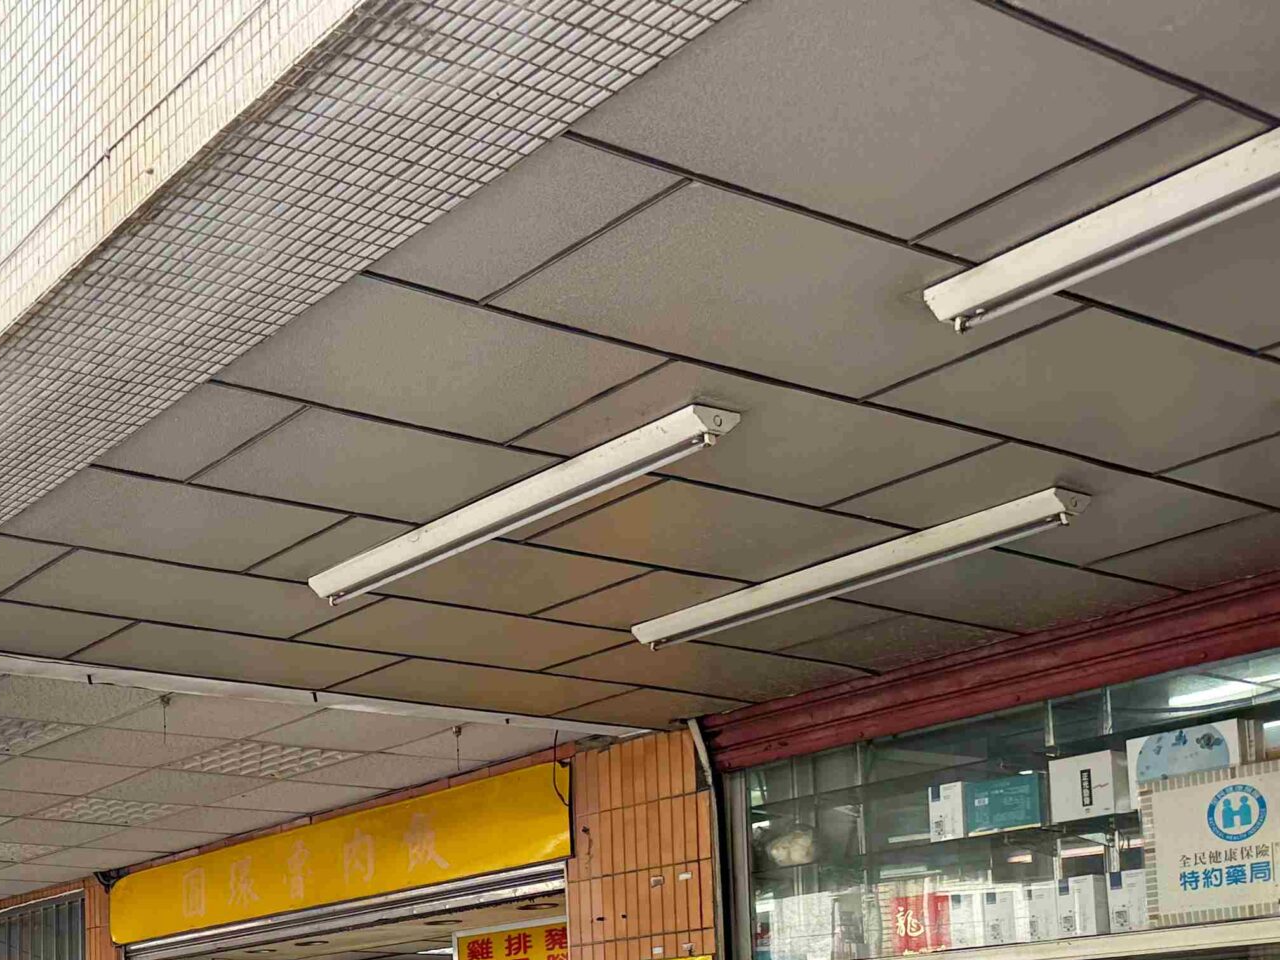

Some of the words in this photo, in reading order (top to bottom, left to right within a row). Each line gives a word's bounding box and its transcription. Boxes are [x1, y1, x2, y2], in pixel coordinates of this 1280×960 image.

[1179, 843, 1271, 869] 全民健康保險
[1179, 860, 1272, 892] 特約藥局
